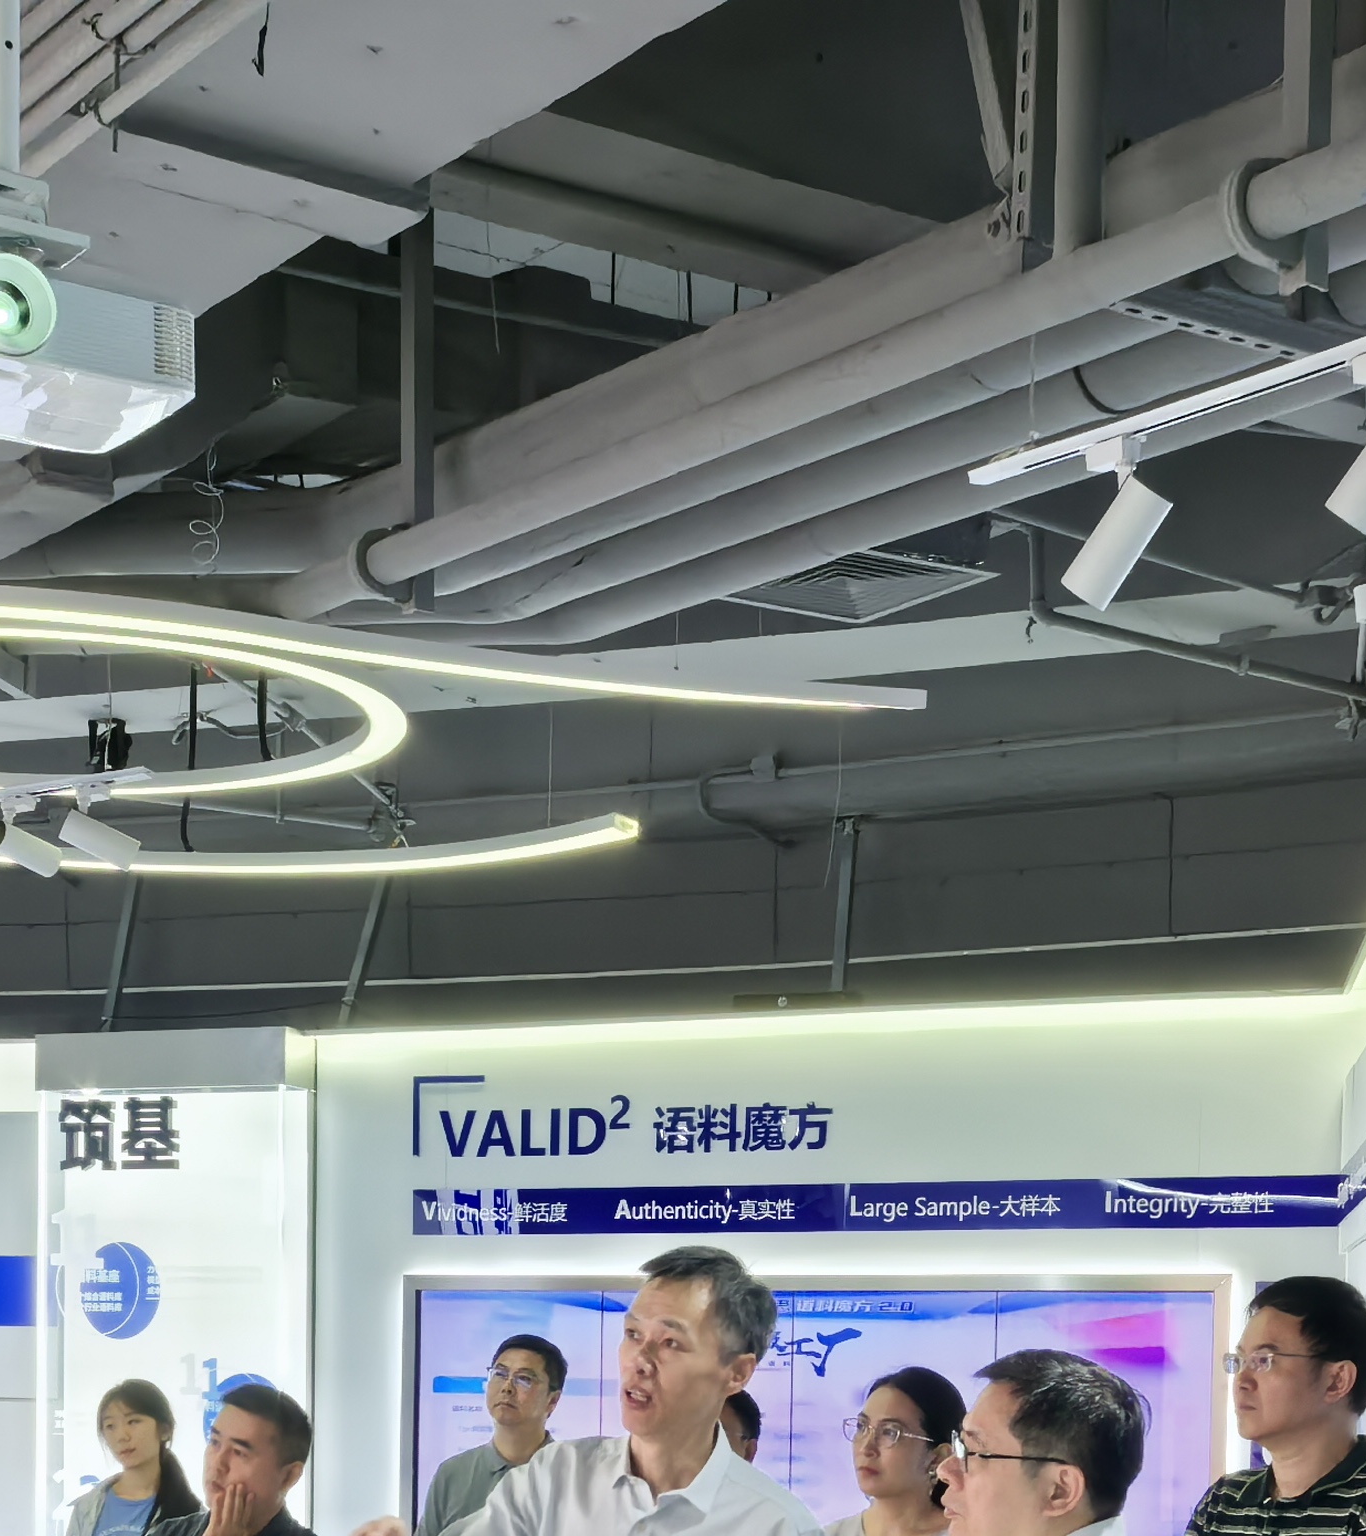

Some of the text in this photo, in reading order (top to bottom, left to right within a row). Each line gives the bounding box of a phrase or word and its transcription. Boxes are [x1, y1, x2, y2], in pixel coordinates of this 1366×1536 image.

[652, 1101, 834, 1154] 语料魔方
[614, 1197, 796, 1224] Authenticity-真实性
[849, 1191, 1061, 1222] Large Sample-大样本
[82, 1302, 123, 1313] 行业语料库
